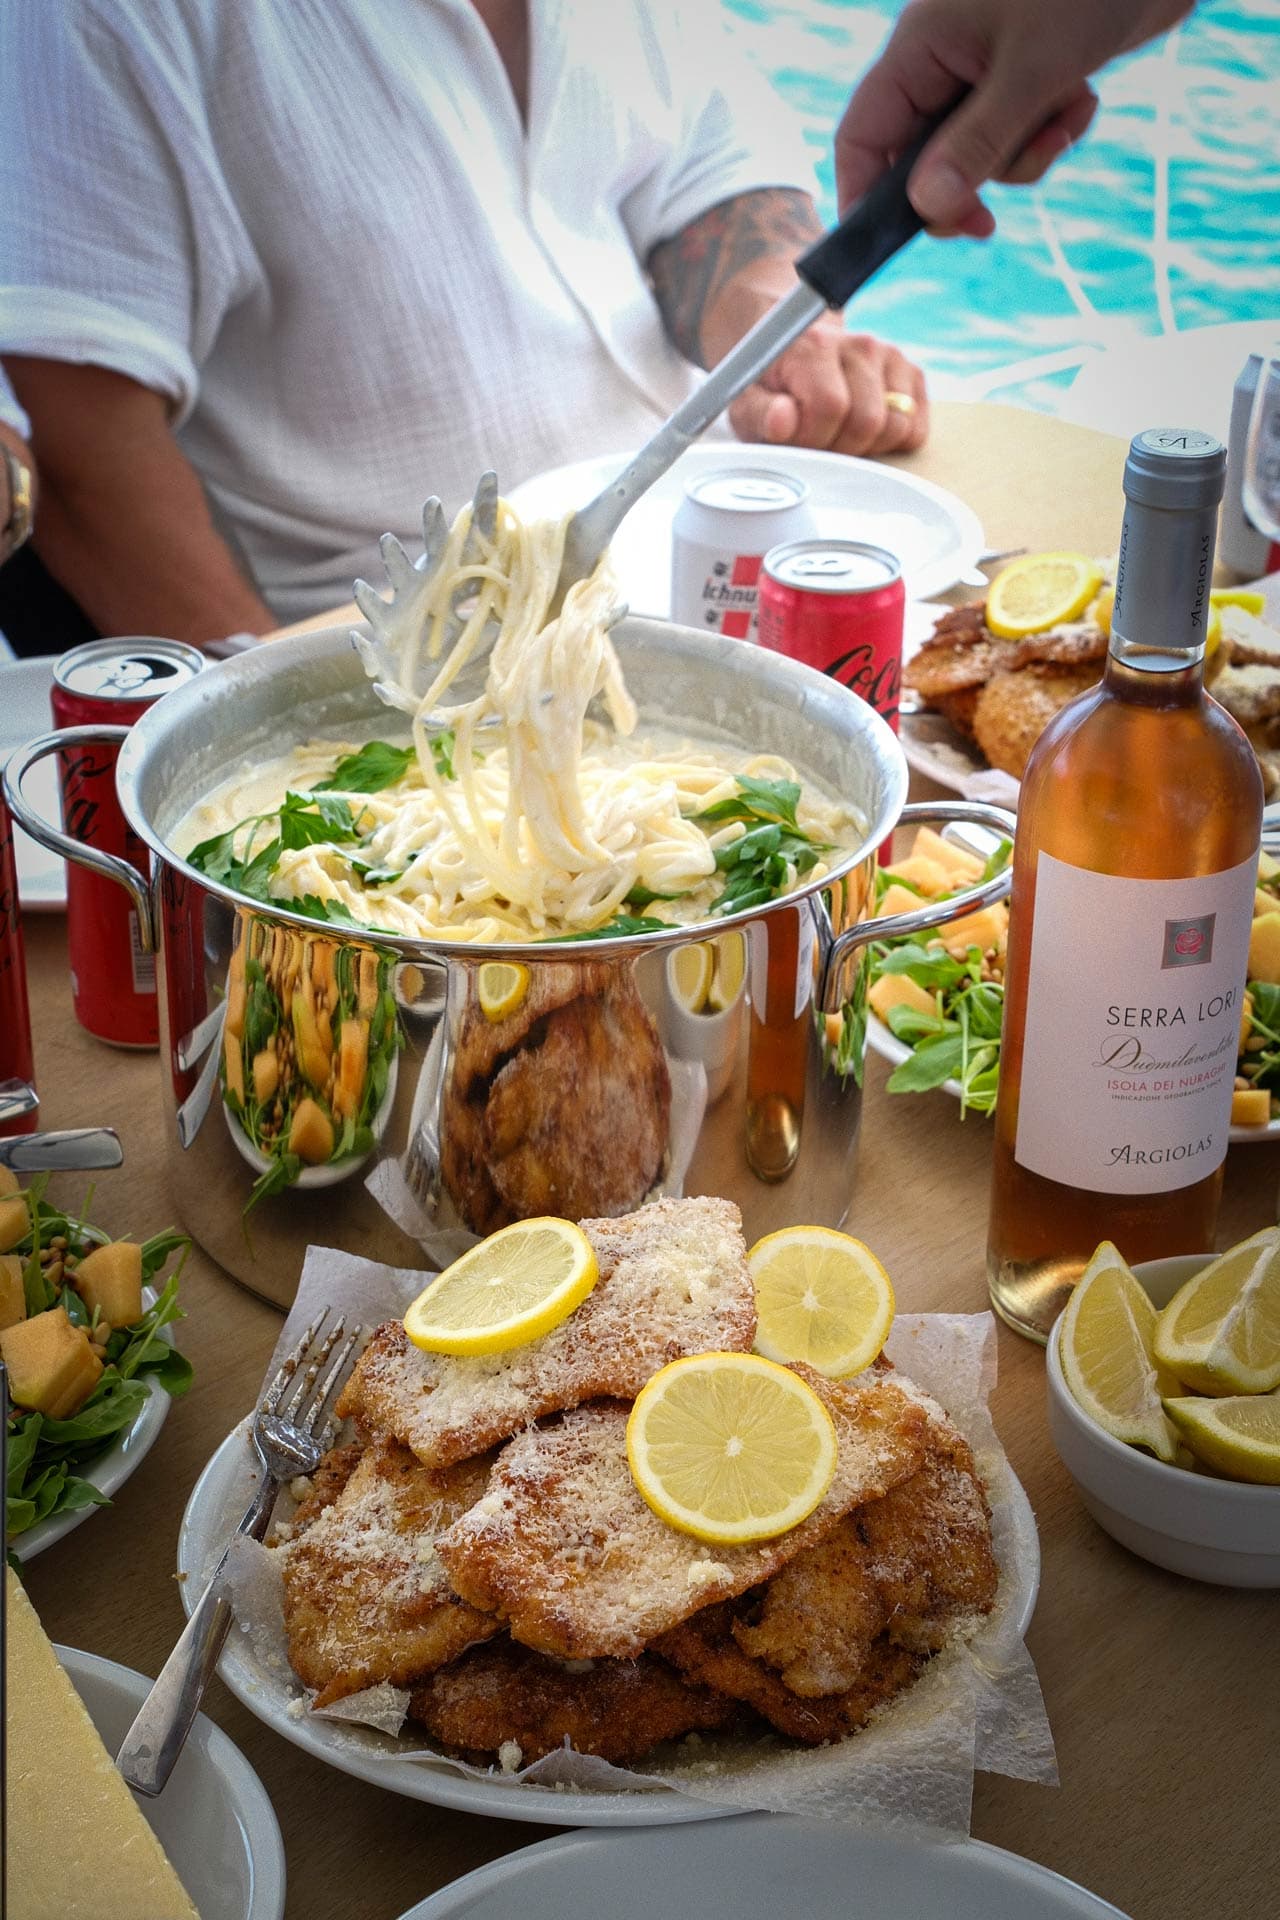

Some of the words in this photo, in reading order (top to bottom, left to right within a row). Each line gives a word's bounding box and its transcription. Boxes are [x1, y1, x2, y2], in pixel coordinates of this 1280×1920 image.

[1191, 535, 1210, 627] ARGIOLAS
[1106, 1006, 1187, 1028] SERRA
[1197, 987, 1237, 1022] LORI
[1107, 1079, 1147, 1092] ISOLA
[1153, 1080, 1174, 1091] DEI
[1179, 1063, 1227, 1089] NURAGHI
[1103, 1134, 1213, 1167] ARGIOLAS
